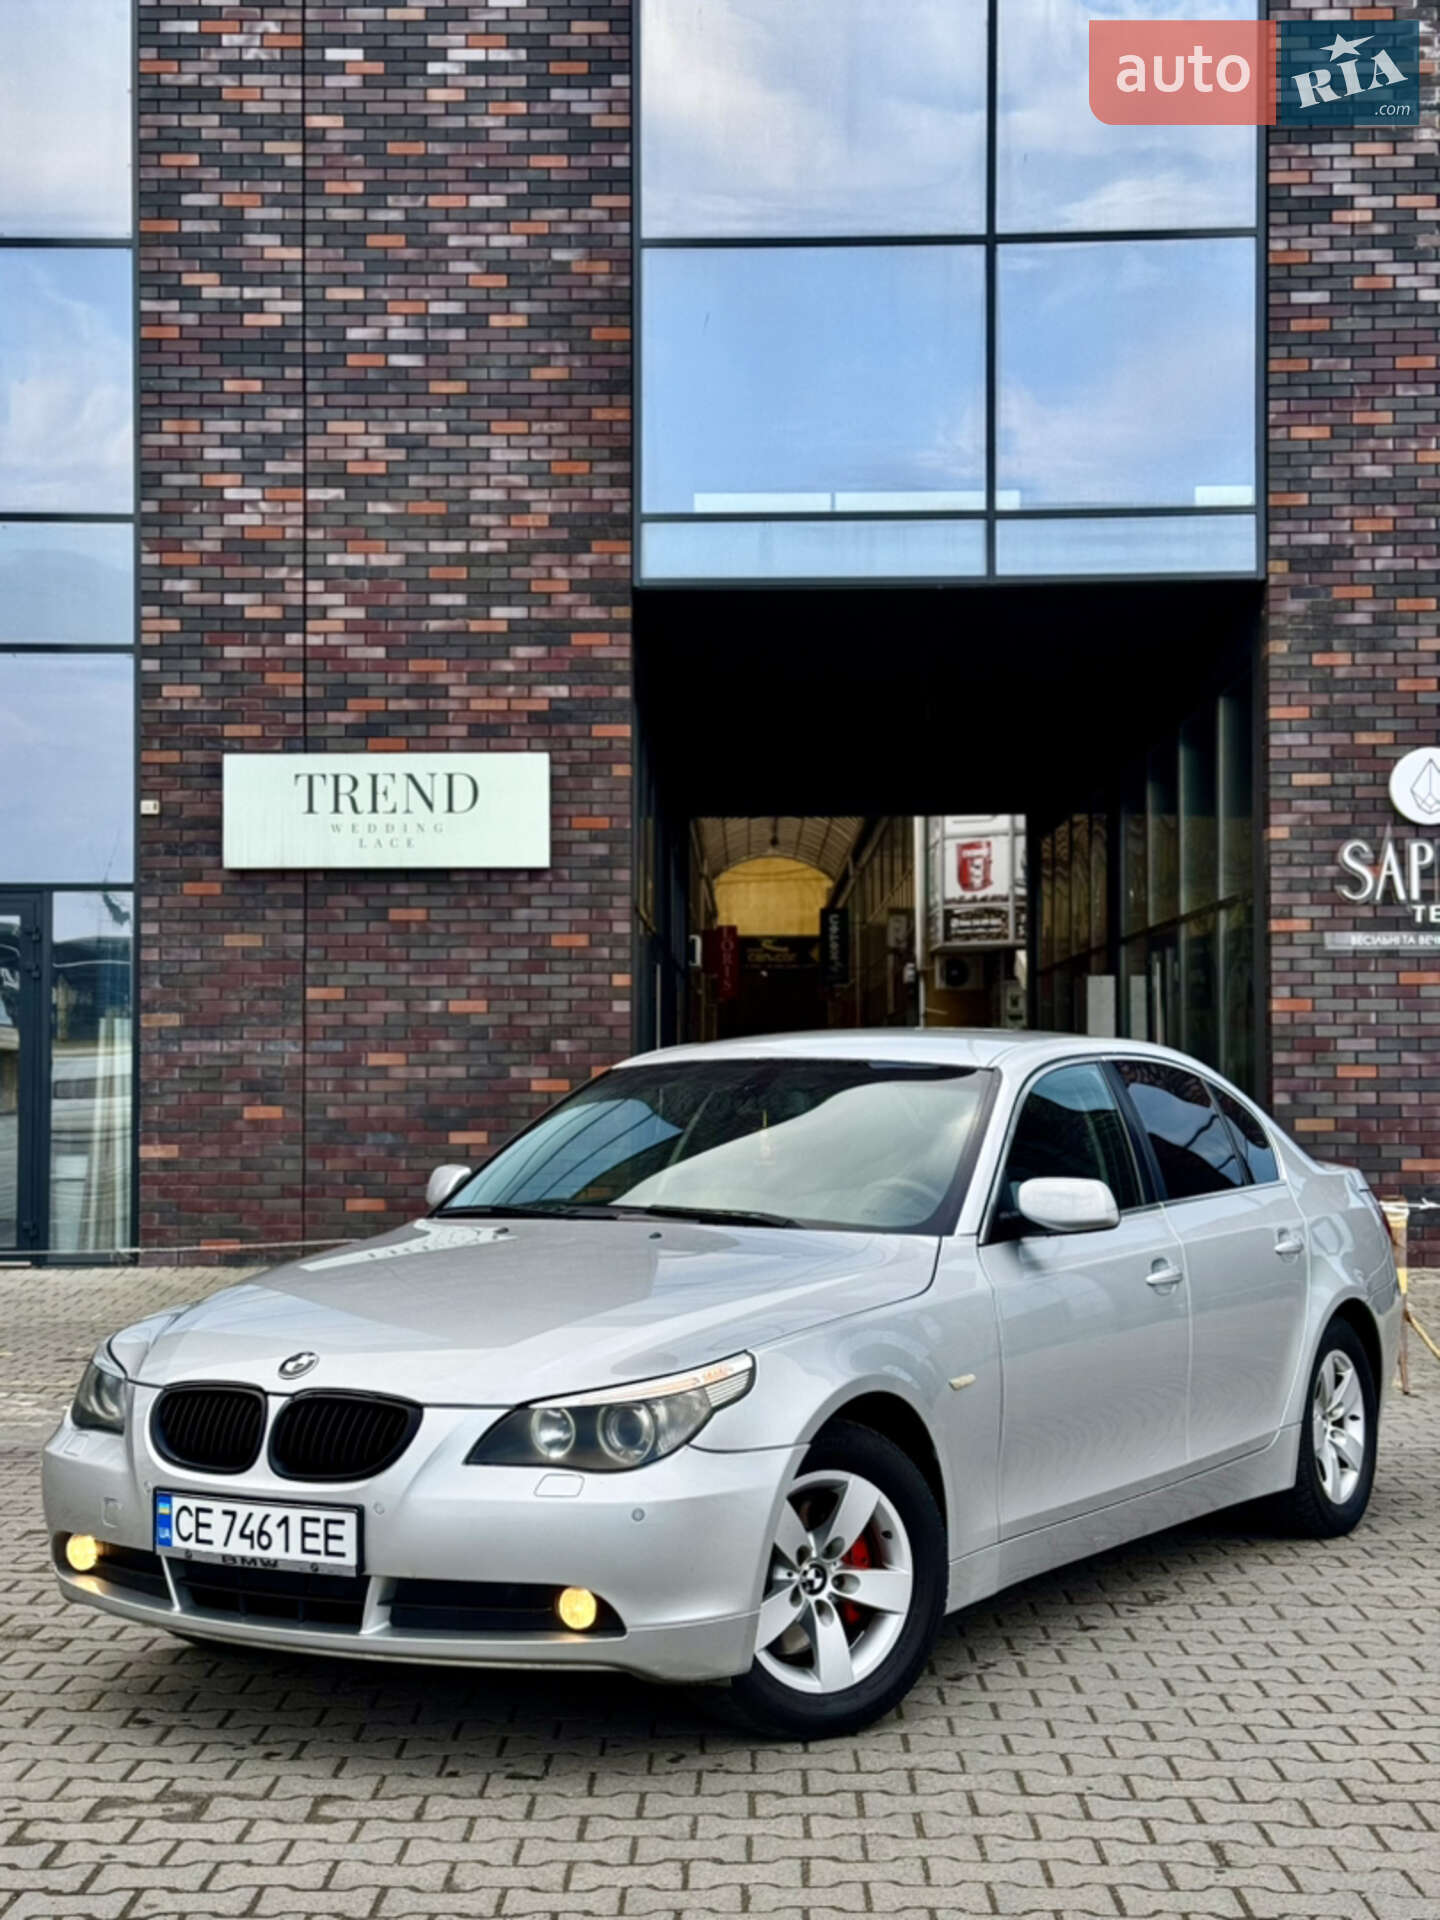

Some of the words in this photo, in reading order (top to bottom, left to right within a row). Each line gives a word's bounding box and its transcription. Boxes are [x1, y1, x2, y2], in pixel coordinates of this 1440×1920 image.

[294, 772, 480, 815] TREND
[330, 823, 444, 834] WEDDING
[358, 838, 415, 849] LACE
[1336, 838, 1440, 902] SAP
[175, 1505, 214, 1545] CE
[221, 1509, 290, 1553] 7461
[301, 1516, 347, 1558] EE
[221, 1554, 279, 1569] BMW
